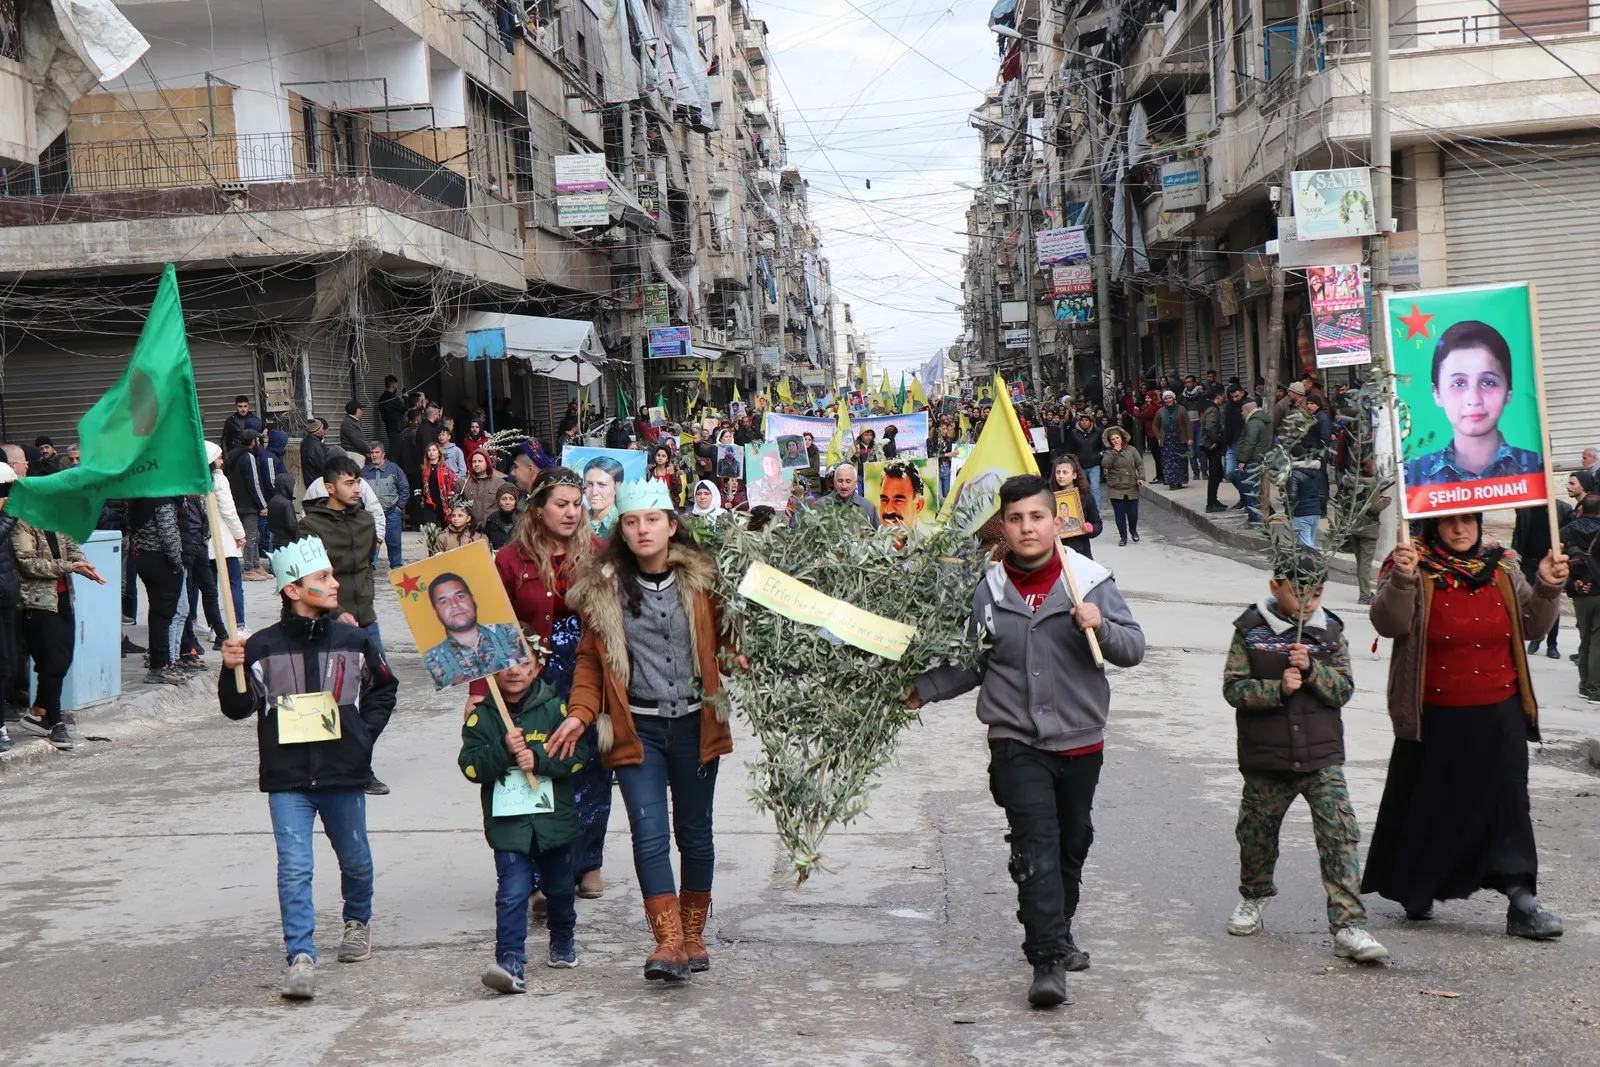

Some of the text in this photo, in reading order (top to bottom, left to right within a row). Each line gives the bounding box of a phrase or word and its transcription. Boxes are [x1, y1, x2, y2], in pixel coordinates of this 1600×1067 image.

[1317, 172, 1367, 190] SAMA
[1428, 479, 1528, 507] ŞEHÎD RONAHÎ
